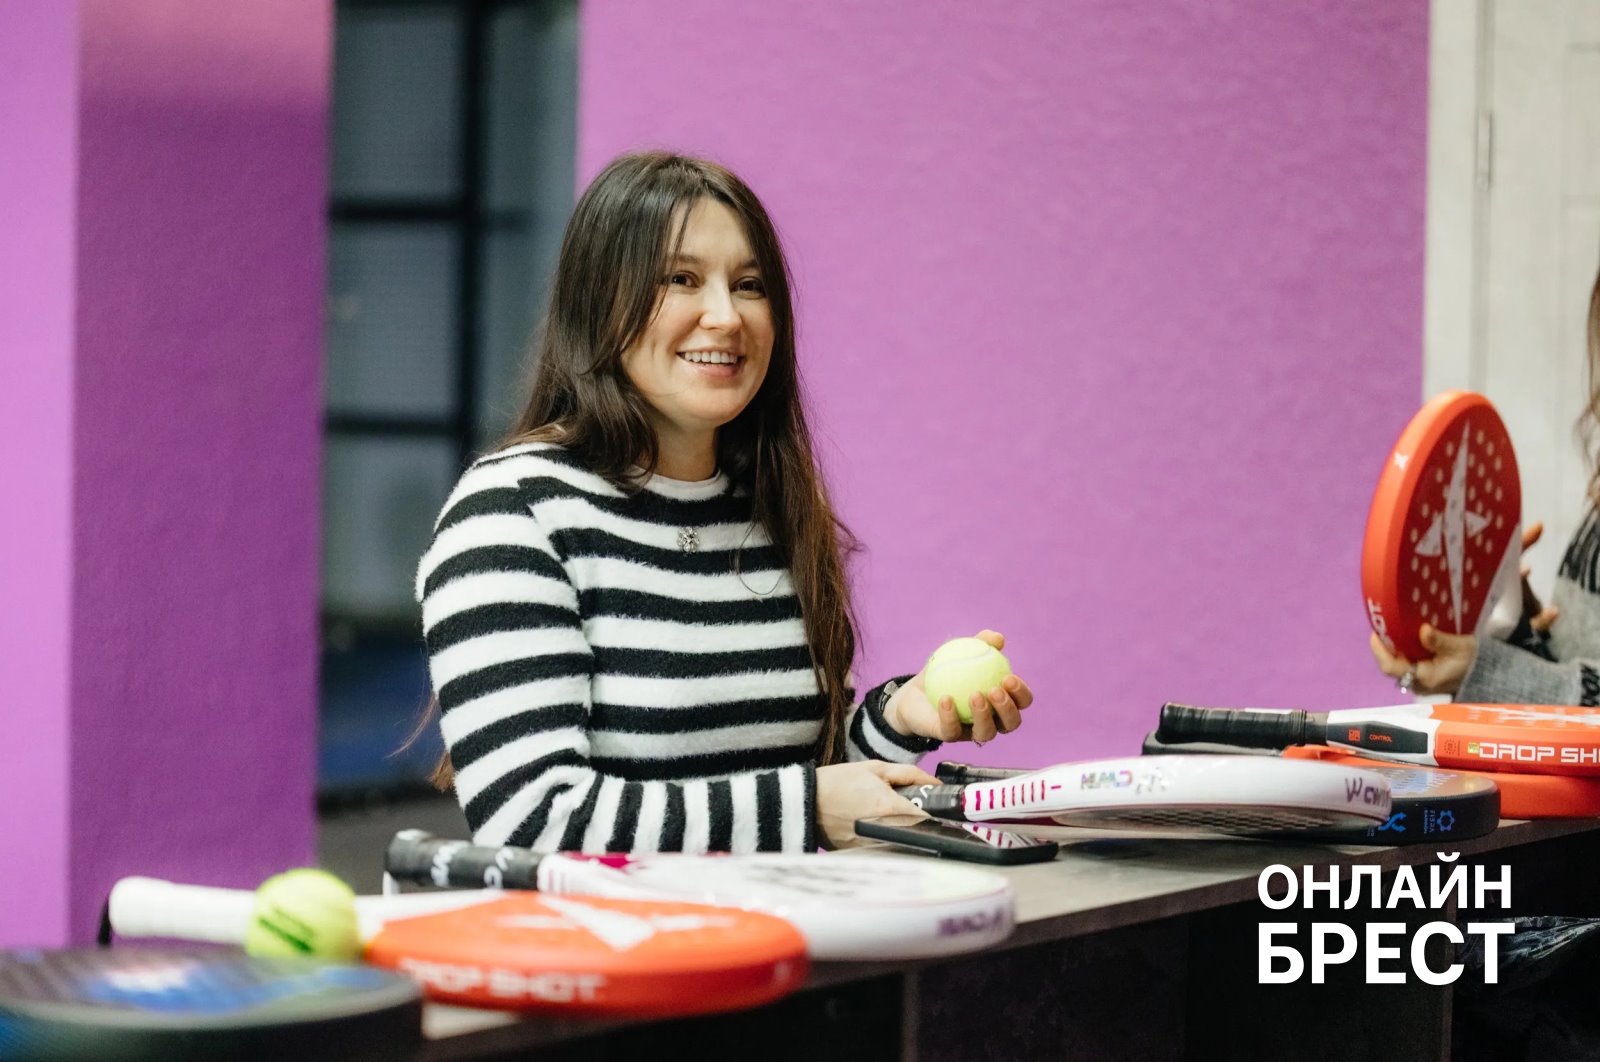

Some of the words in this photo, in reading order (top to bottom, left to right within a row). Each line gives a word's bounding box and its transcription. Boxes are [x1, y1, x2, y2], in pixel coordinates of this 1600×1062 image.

[1369, 734, 1394, 743] CONTROL
[1479, 742, 1555, 762] DROP
[1560, 747, 1600, 763] SH
